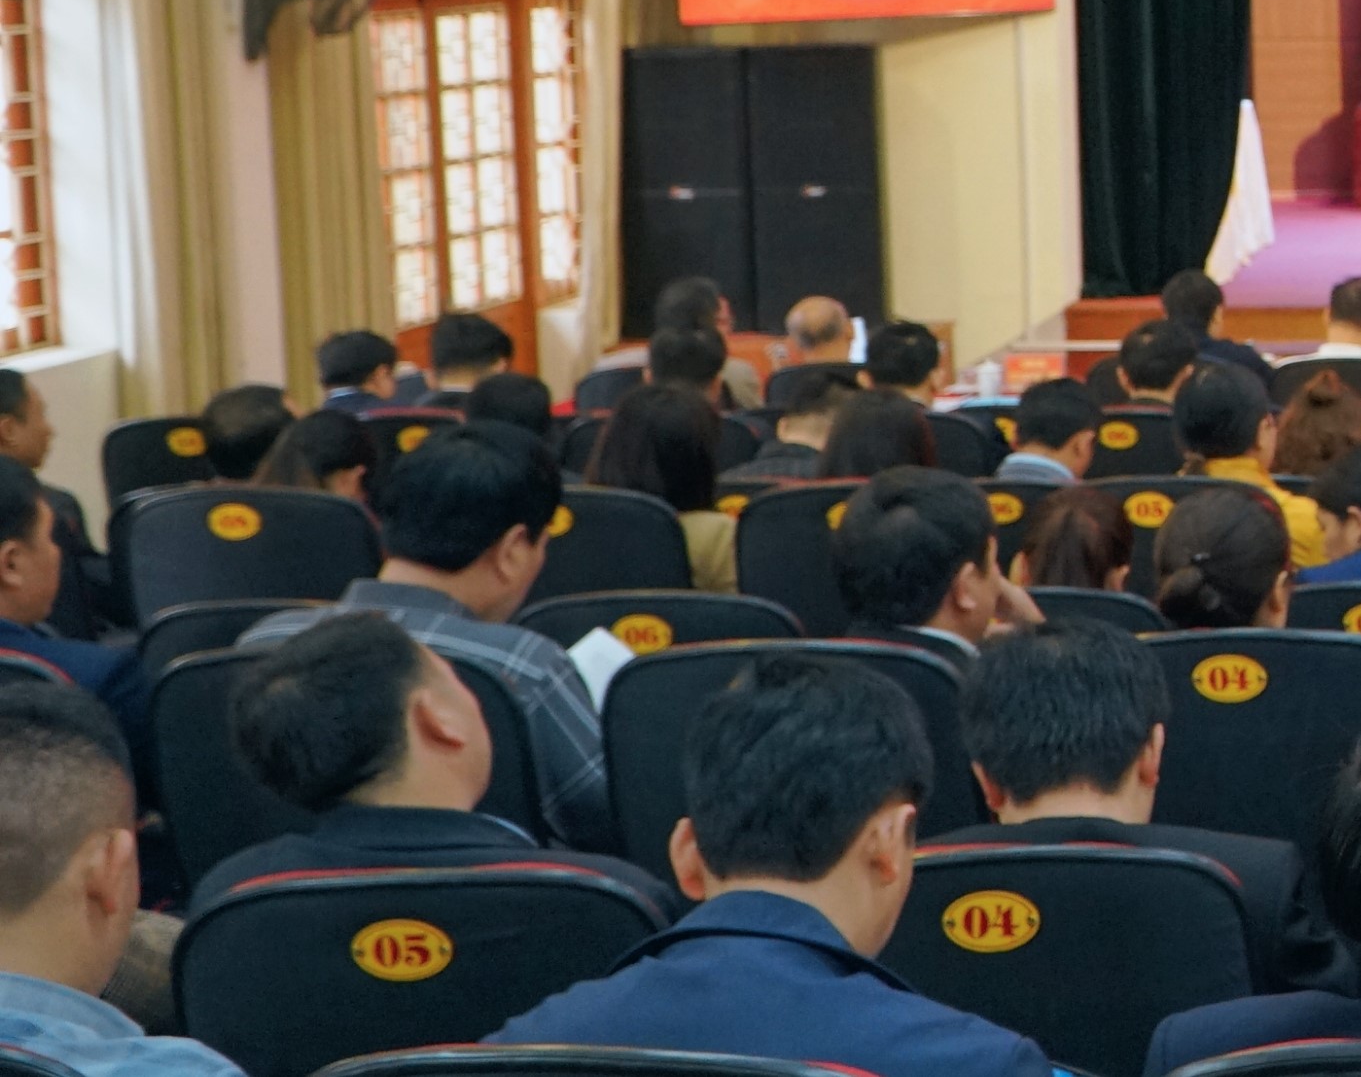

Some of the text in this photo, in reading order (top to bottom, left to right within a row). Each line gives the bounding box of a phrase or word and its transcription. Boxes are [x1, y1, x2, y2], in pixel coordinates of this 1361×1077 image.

[1209, 666, 1248, 692] 04
[963, 904, 1016, 939] 04
[373, 935, 431, 969] 05
